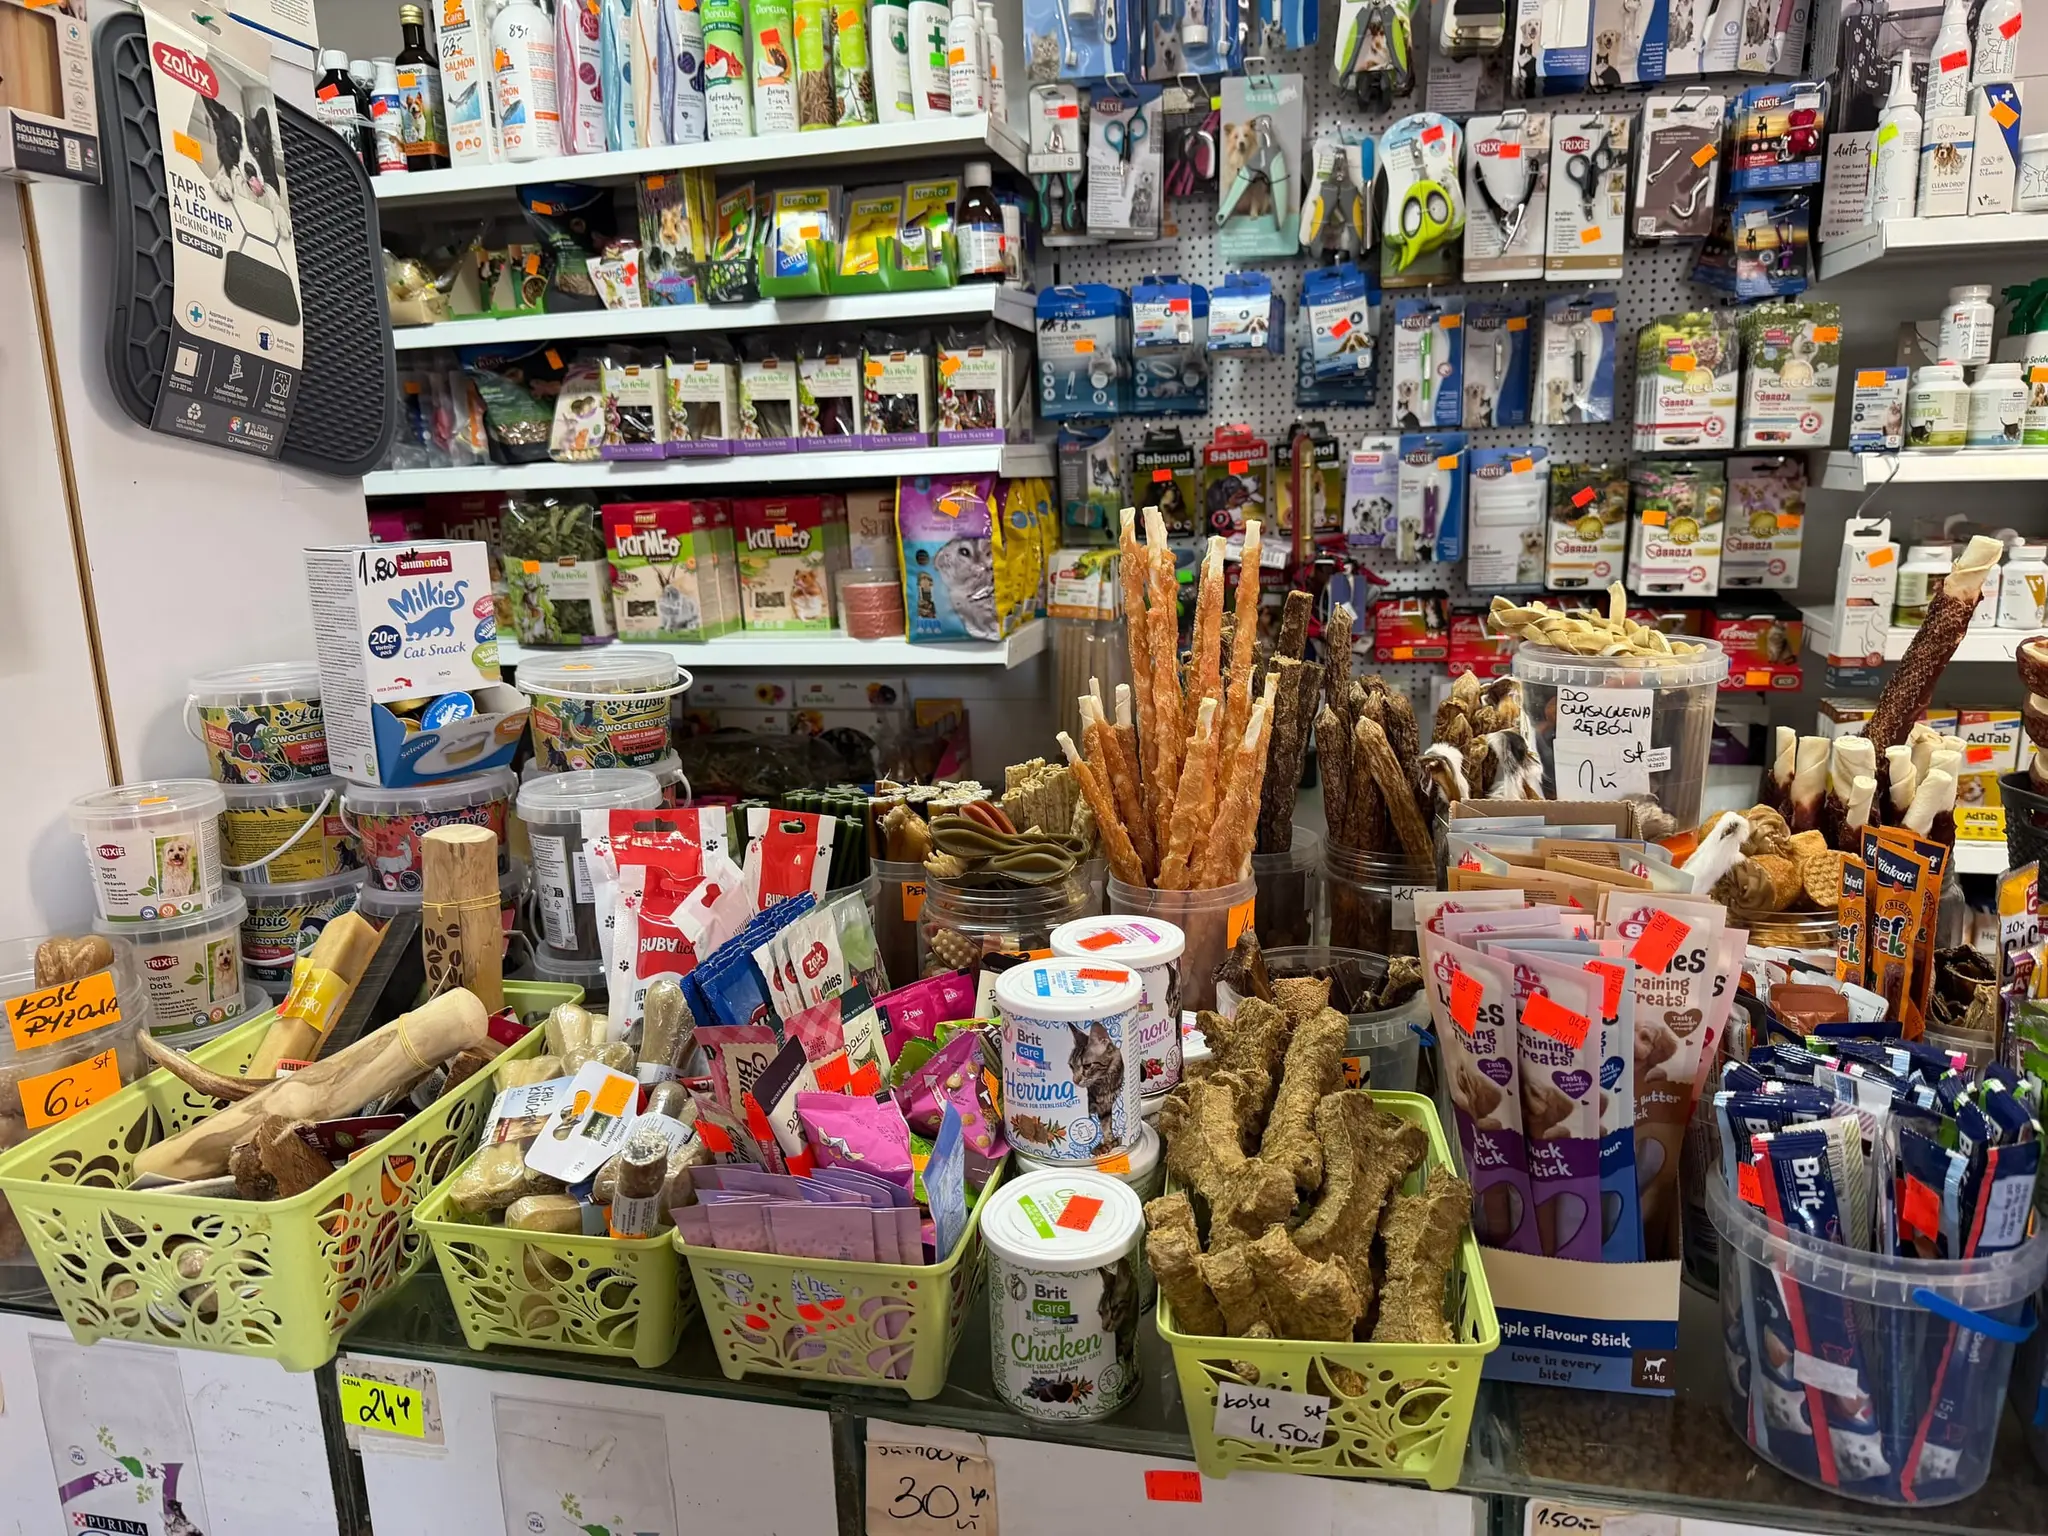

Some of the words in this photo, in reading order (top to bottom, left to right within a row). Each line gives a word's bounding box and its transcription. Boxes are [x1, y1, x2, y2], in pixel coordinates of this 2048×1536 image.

[1745, 52, 1756, 60] LED
[445, 56, 475, 72] SALMON
[455, 71, 468, 81] OIL
[1754, 98, 1780, 109] TRIXIE
[15, 122, 51, 138] ROULEAU
[53, 128, 59, 140] À
[16, 132, 60, 150] FRIANDISES
[1560, 139, 1590, 151] TRIXIE
[169, 171, 206, 201] TAPIS
[1931, 181, 1948, 189] CLEAN
[913, 188, 949, 200] Nestor
[173, 190, 182, 211] À
[186, 199, 234, 233] LÉCHER
[174, 212, 208, 236] LICKING
[210, 229, 227, 244] MAT
[181, 234, 219, 255] EXPERT
[1401, 319, 1432, 329] TRIXIE
[249, 428, 273, 441] ANIMALS
[969, 431, 994, 440] NATURE
[1136, 452, 1191, 465] Sabunol
[1210, 446, 1264, 462] Sabunol
[1405, 453, 1435, 464] TRIXIE
[1476, 467, 1505, 477] TRIXIE
[388, 578, 469, 621] Milkies
[370, 631, 399, 645] 20er
[403, 647, 426, 660] Cat
[428, 641, 466, 656] Snack
[1560, 689, 1589, 702] DO
[597, 723, 632, 733] OWOCE
[270, 733, 307, 744] OWOCE
[1967, 733, 2011, 744] AdTab
[400, 736, 438, 758] Selection
[1964, 812, 1998, 821] AdTab
[97, 846, 125, 857] TRIXIE
[102, 872, 116, 880] Dots
[2006, 921, 2025, 934] 10x
[145, 957, 179, 969] TRIXIE
[148, 974, 170, 982] Vegan
[149, 981, 173, 990] Dots
[1634, 977, 1690, 996] raining
[903, 1010, 909, 1020] 3
[1017, 1031, 1042, 1046] Brit
[1019, 1048, 1040, 1061] care
[1487, 1062, 1505, 1070] Tasty
[1005, 1067, 1077, 1101] Herring
[1560, 1075, 1583, 1083] Tasty
[44, 1078, 74, 1117] 6
[1640, 1093, 1681, 1106] Butter
[1790, 1157, 1822, 1211] Brit
[1035, 1284, 1067, 1299] Brit
[1037, 1303, 1065, 1314] care
[1032, 1326, 1073, 1338] Superfruits
[1499, 1322, 1530, 1338] riple
[1533, 1325, 1588, 1343] Flavour
[1592, 1332, 1632, 1349] Stick
[1011, 1333, 1102, 1361] Chicken
[1013, 1360, 1035, 1369] CRUNCHY
[1056, 1361, 1067, 1369] FOR
[1068, 1357, 1087, 1367] ADULT
[1511, 1352, 1542, 1366] Love
[1545, 1354, 1558, 1366] in
[1561, 1358, 1601, 1374] every
[1538, 1367, 1572, 1382] bite!
[1654, 1373, 1666, 1383] kg
[342, 1378, 361, 1388] CENA
[71, 1453, 84, 1461] 1926
[888, 1476, 960, 1519] 30
[88, 1515, 146, 1535] PURINA
[529, 1519, 543, 1528] 1926
[1537, 1508, 1578, 1529] 1.50
